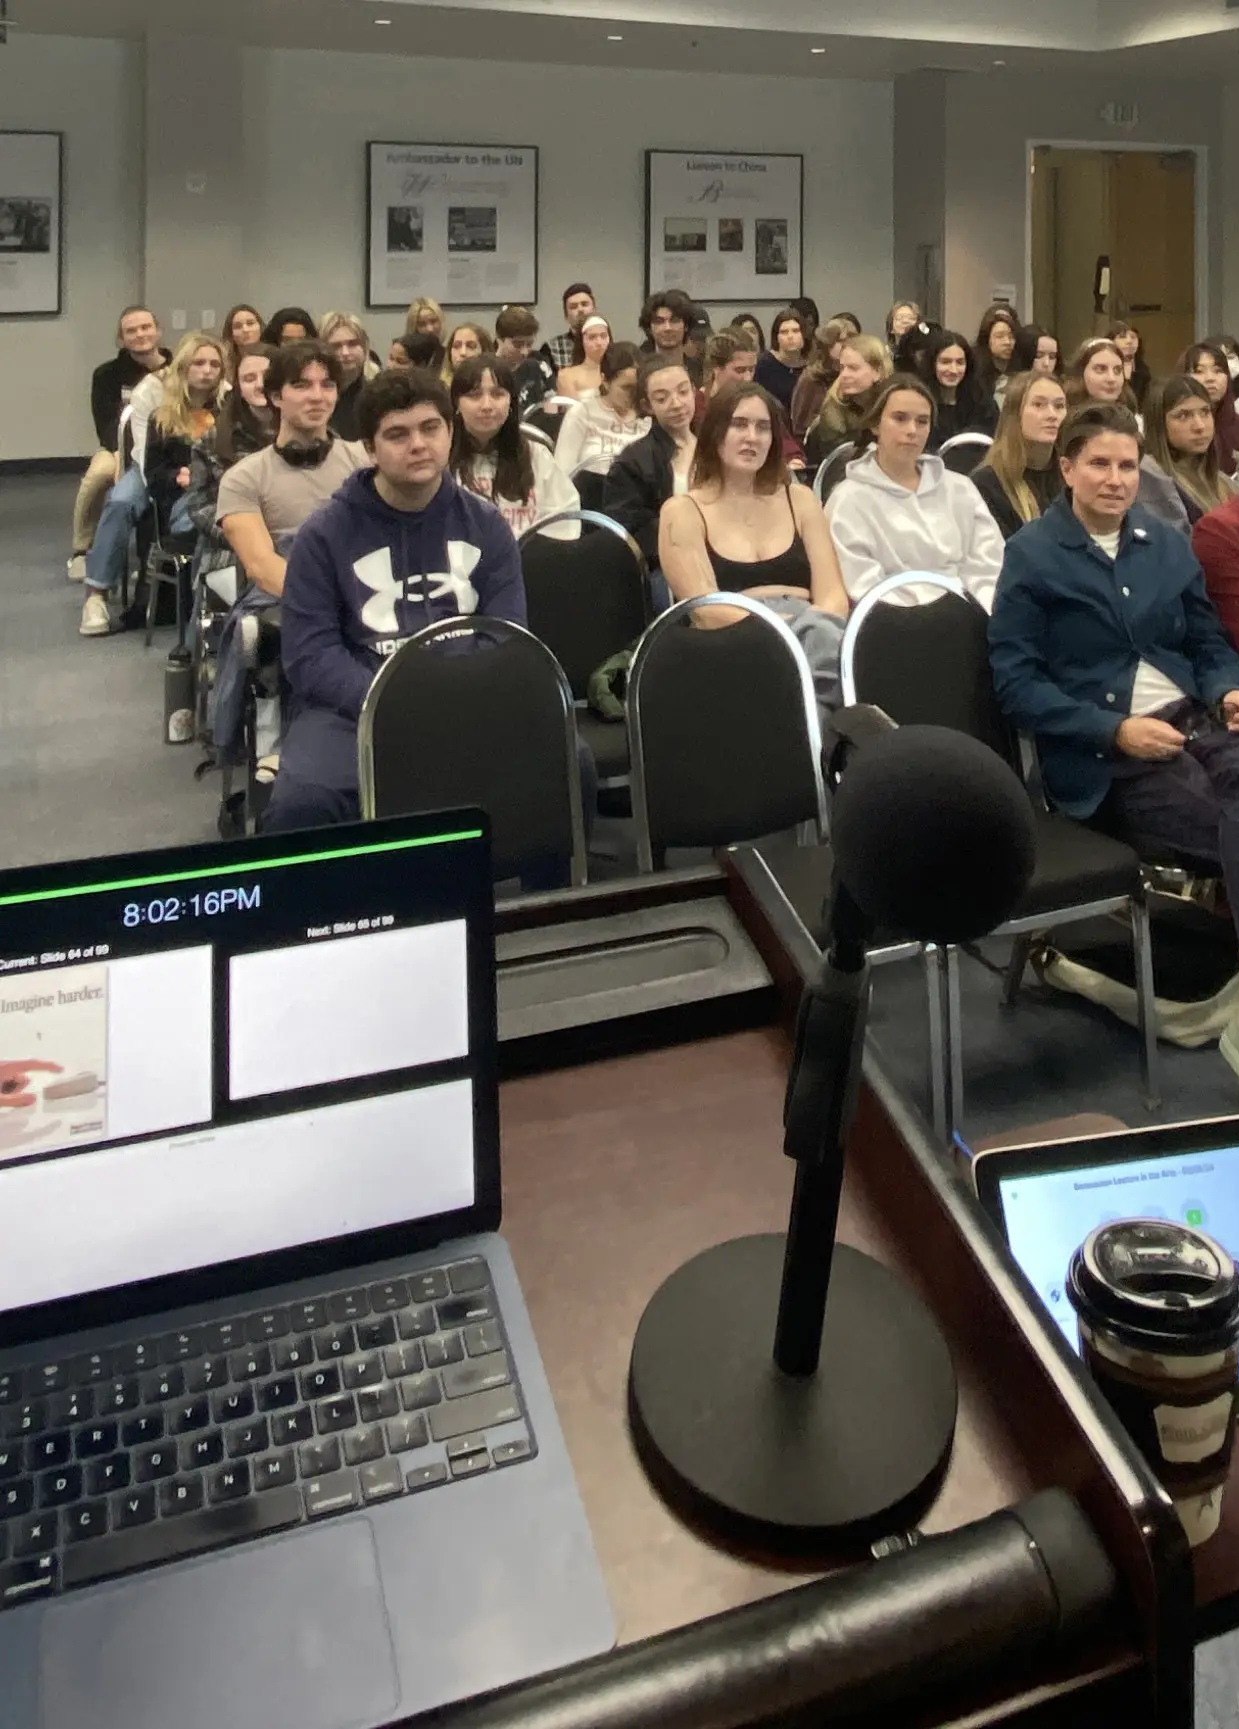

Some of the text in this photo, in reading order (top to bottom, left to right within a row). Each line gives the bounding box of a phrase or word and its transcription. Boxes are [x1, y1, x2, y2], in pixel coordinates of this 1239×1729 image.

[465, 154, 478, 165] to
[482, 153, 501, 166] the
[738, 161, 767, 172] China
[123, 884, 261, 928] 8:02:16PM
[40, 952, 67, 964] Slide
[83, 945, 94, 958] of
[1, 994, 55, 1014] Imagine
